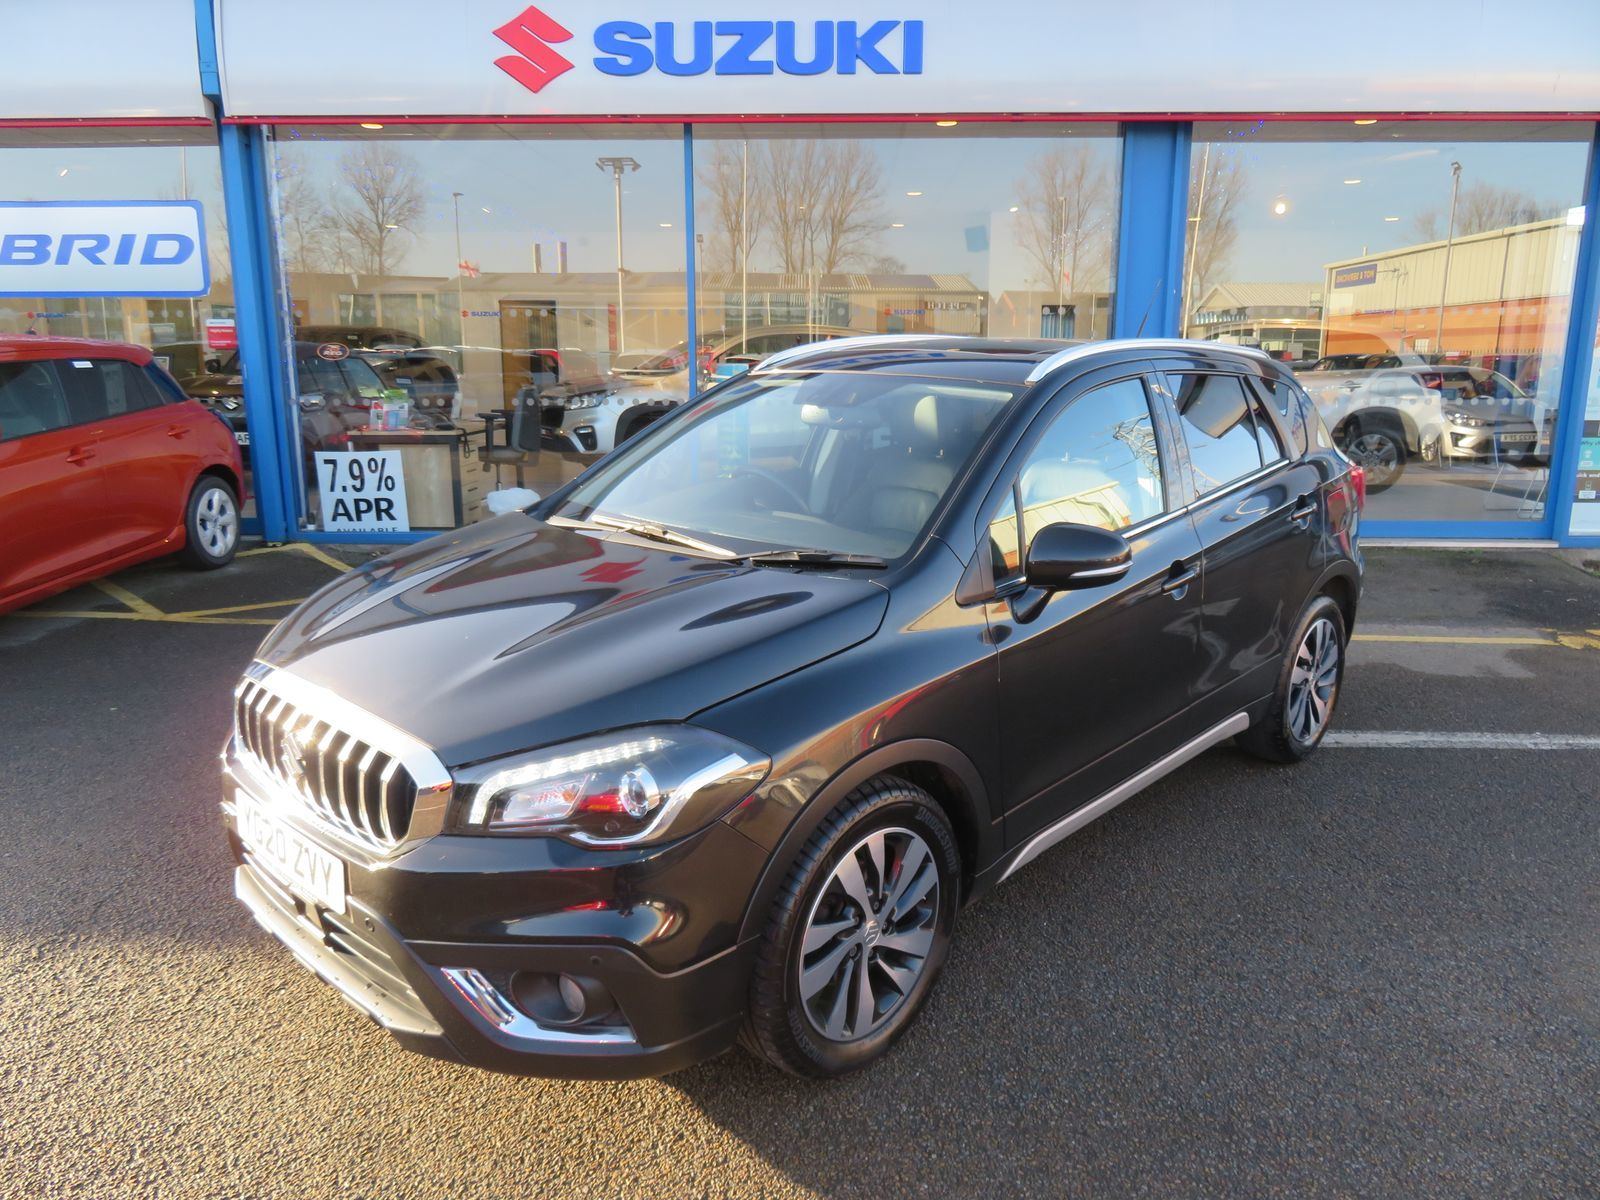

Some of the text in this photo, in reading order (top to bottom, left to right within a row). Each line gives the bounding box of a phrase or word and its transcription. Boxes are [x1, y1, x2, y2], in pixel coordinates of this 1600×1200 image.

[593, 20, 924, 76] SUZUKI
[0, 234, 195, 265] BRID
[323, 457, 396, 493] 7.9%
[331, 497, 397, 522] APR
[293, 838, 332, 896] ZVY
